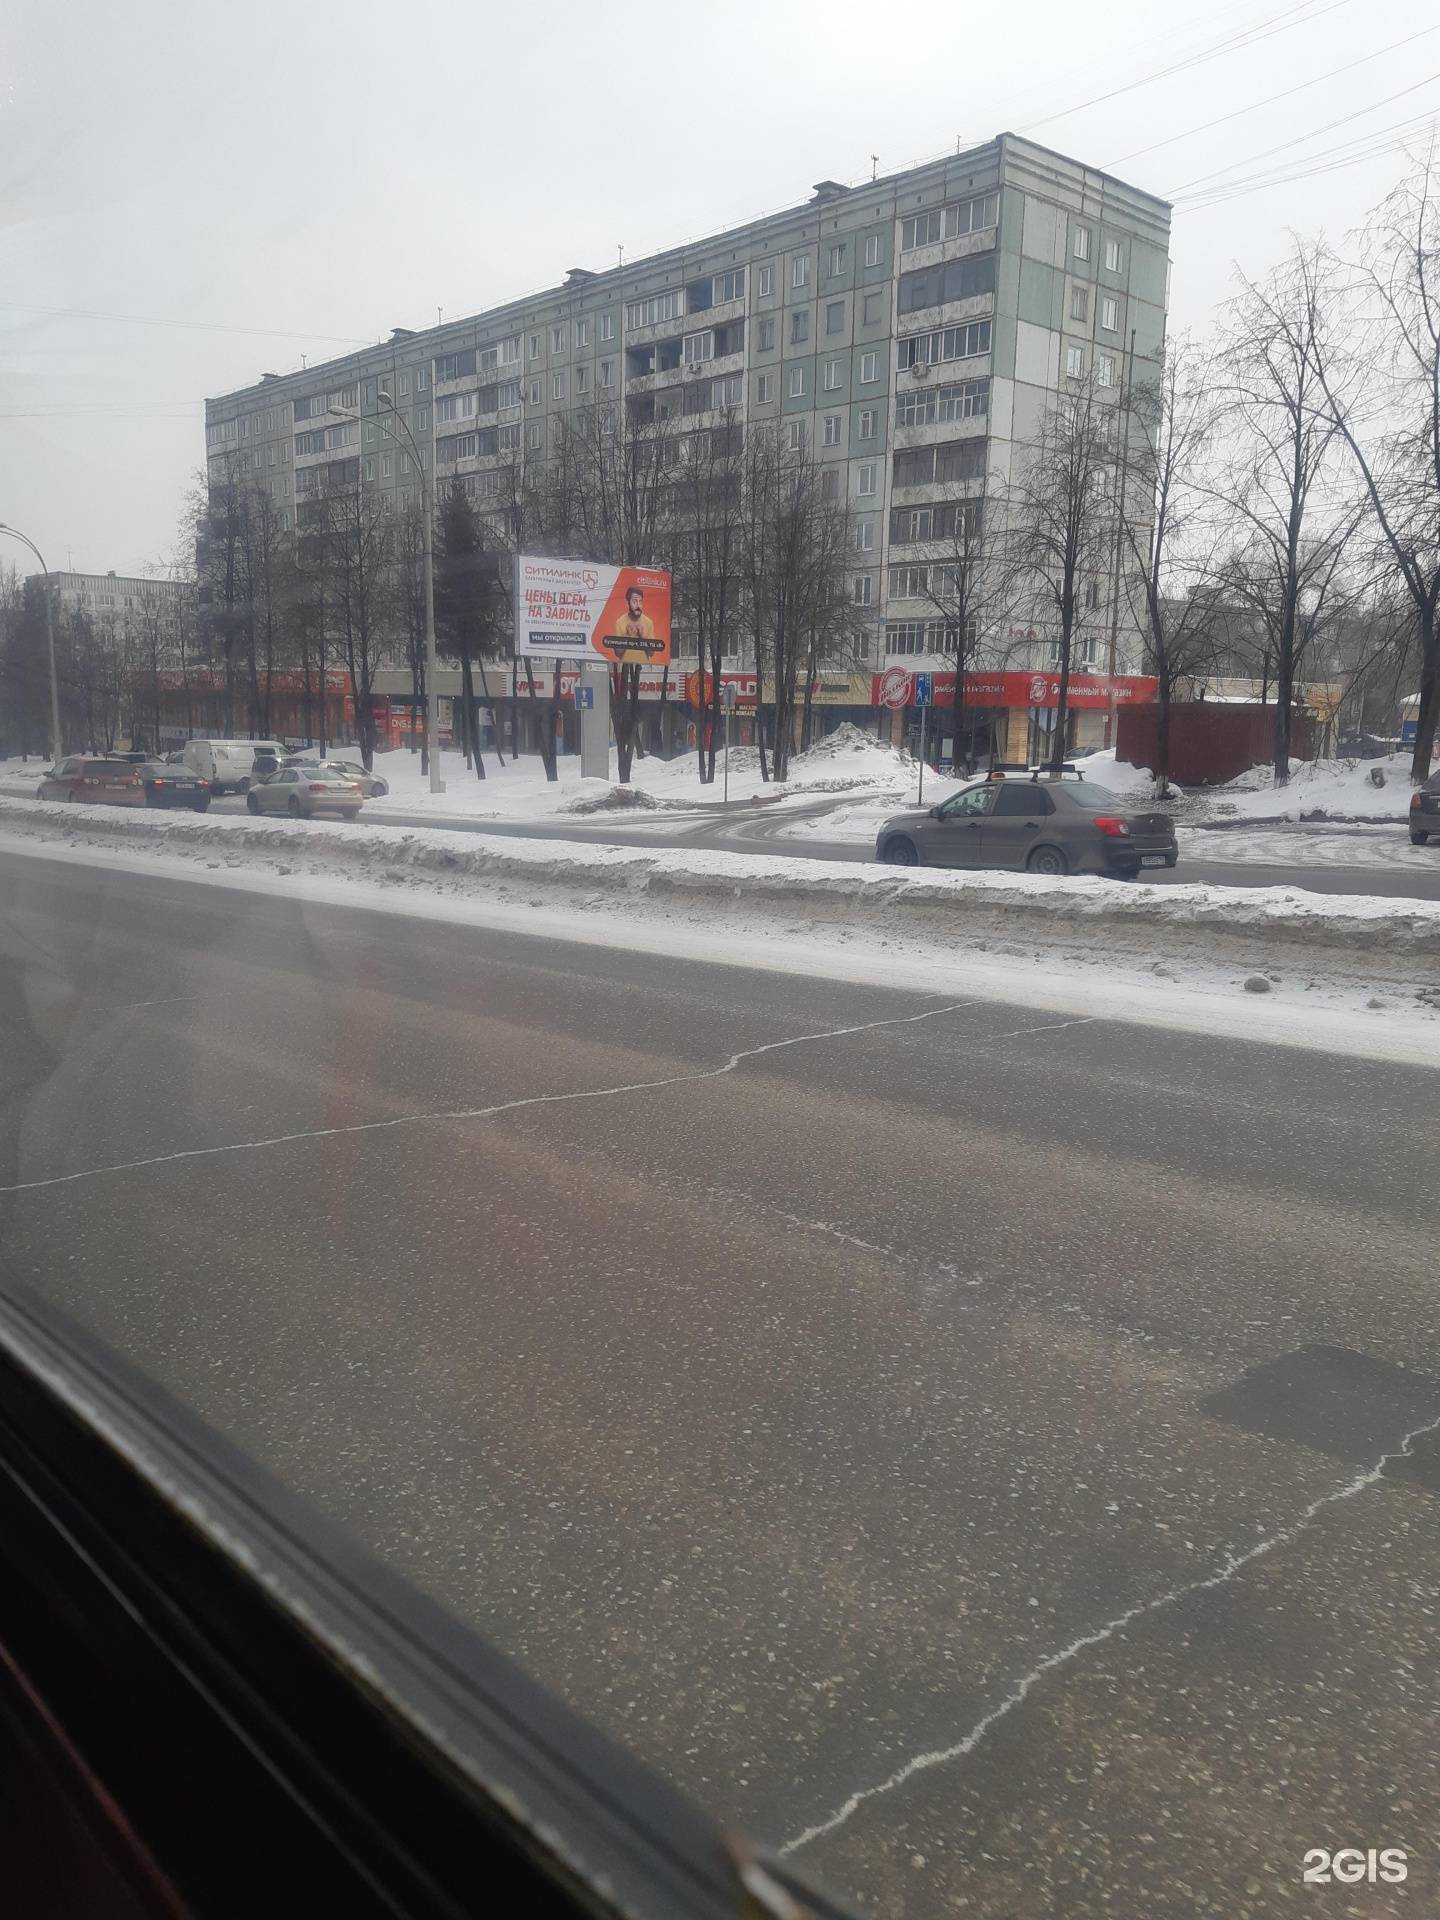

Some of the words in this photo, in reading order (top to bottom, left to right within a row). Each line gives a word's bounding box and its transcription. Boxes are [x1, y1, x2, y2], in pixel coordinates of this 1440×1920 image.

[525, 566, 581, 579] СИТИЛИНК
[525, 589, 557, 604] ЦЕНЫ
[559, 591, 587, 606] ВСЕМ
[528, 604, 542, 618] НА
[546, 606, 591, 622] ЗАВИСТЬ
[1051, 683, 1099, 696] Фменный
[1101, 687, 1132, 697] мгазин
